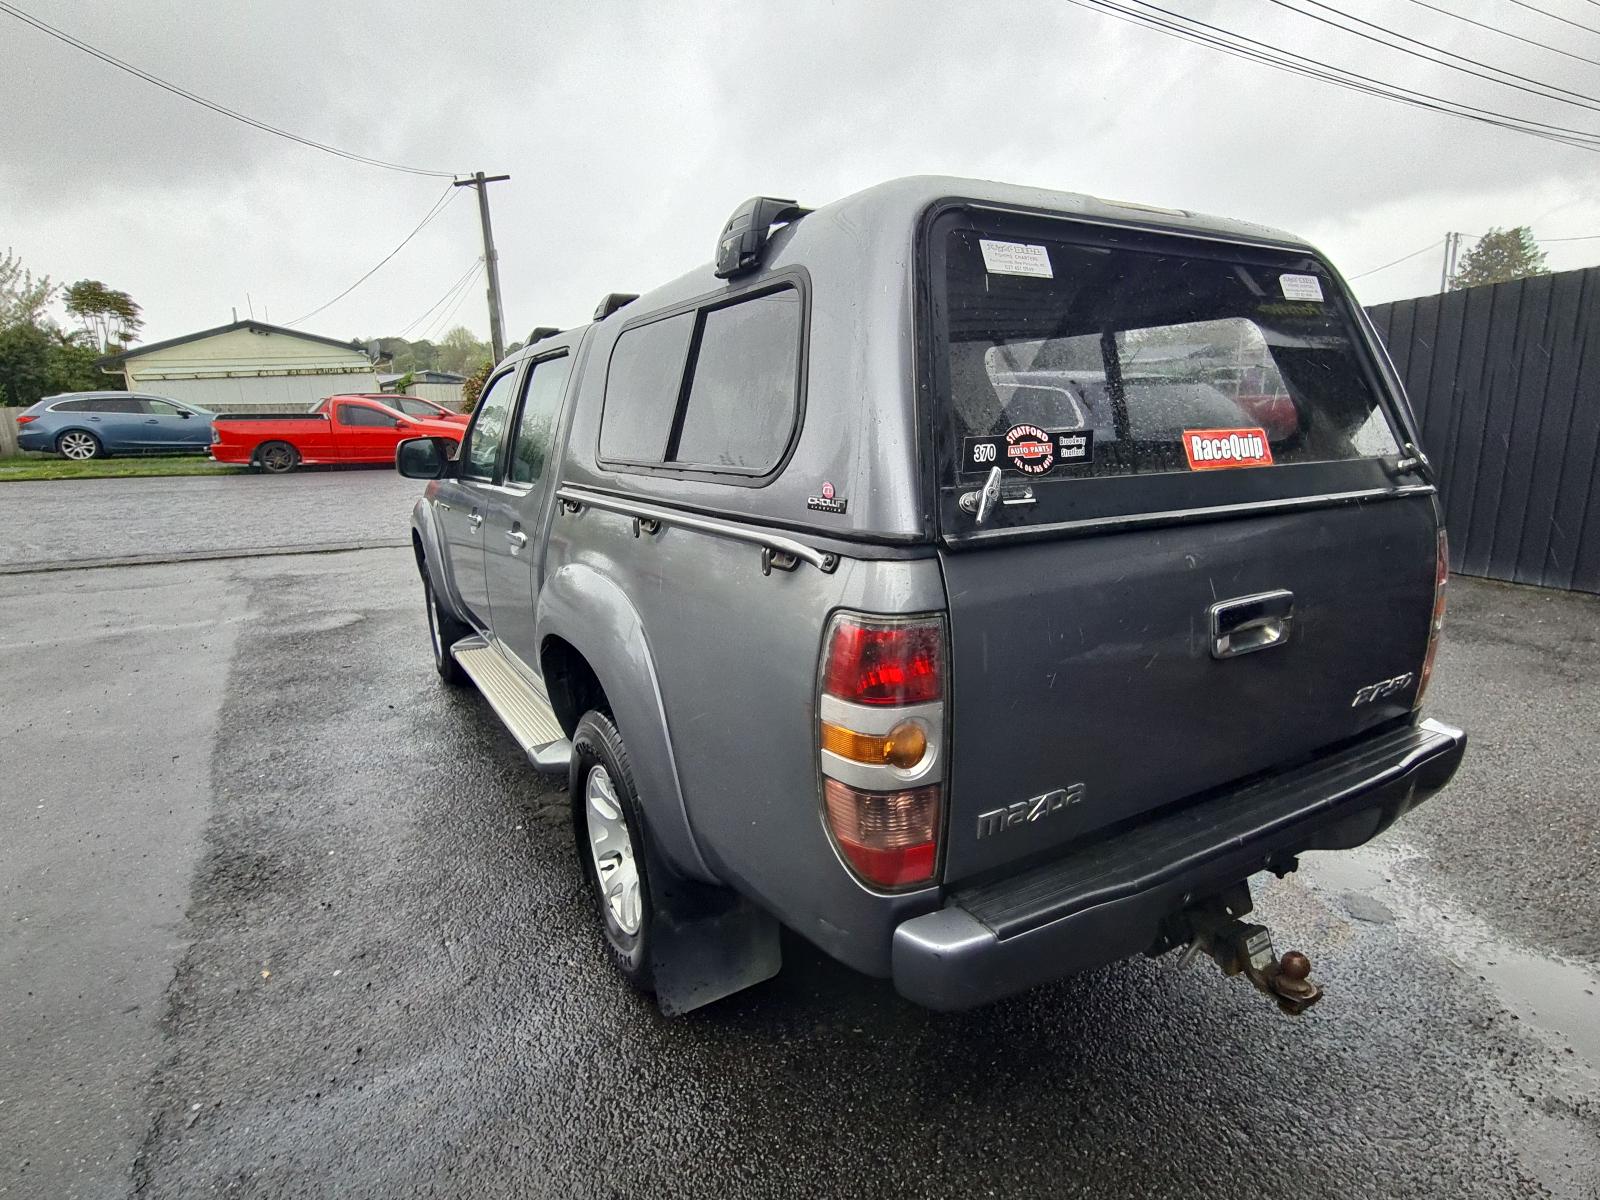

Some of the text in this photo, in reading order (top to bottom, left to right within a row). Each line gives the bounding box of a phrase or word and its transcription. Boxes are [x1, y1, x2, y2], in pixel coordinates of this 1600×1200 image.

[1006, 425, 1049, 444] STRATFORD
[1059, 435, 1086, 446] Broadway
[973, 443, 997, 463] 370
[1010, 445, 1050, 455] AUTO PARTS
[1060, 446, 1086, 458] Stratford
[1191, 433, 1264, 461] RaceQuip
[1014, 457, 1024, 469] TEL
[1024, 464, 1033, 473] 06
[1033, 465, 1044, 473] 765
[976, 782, 1087, 840] mazda
